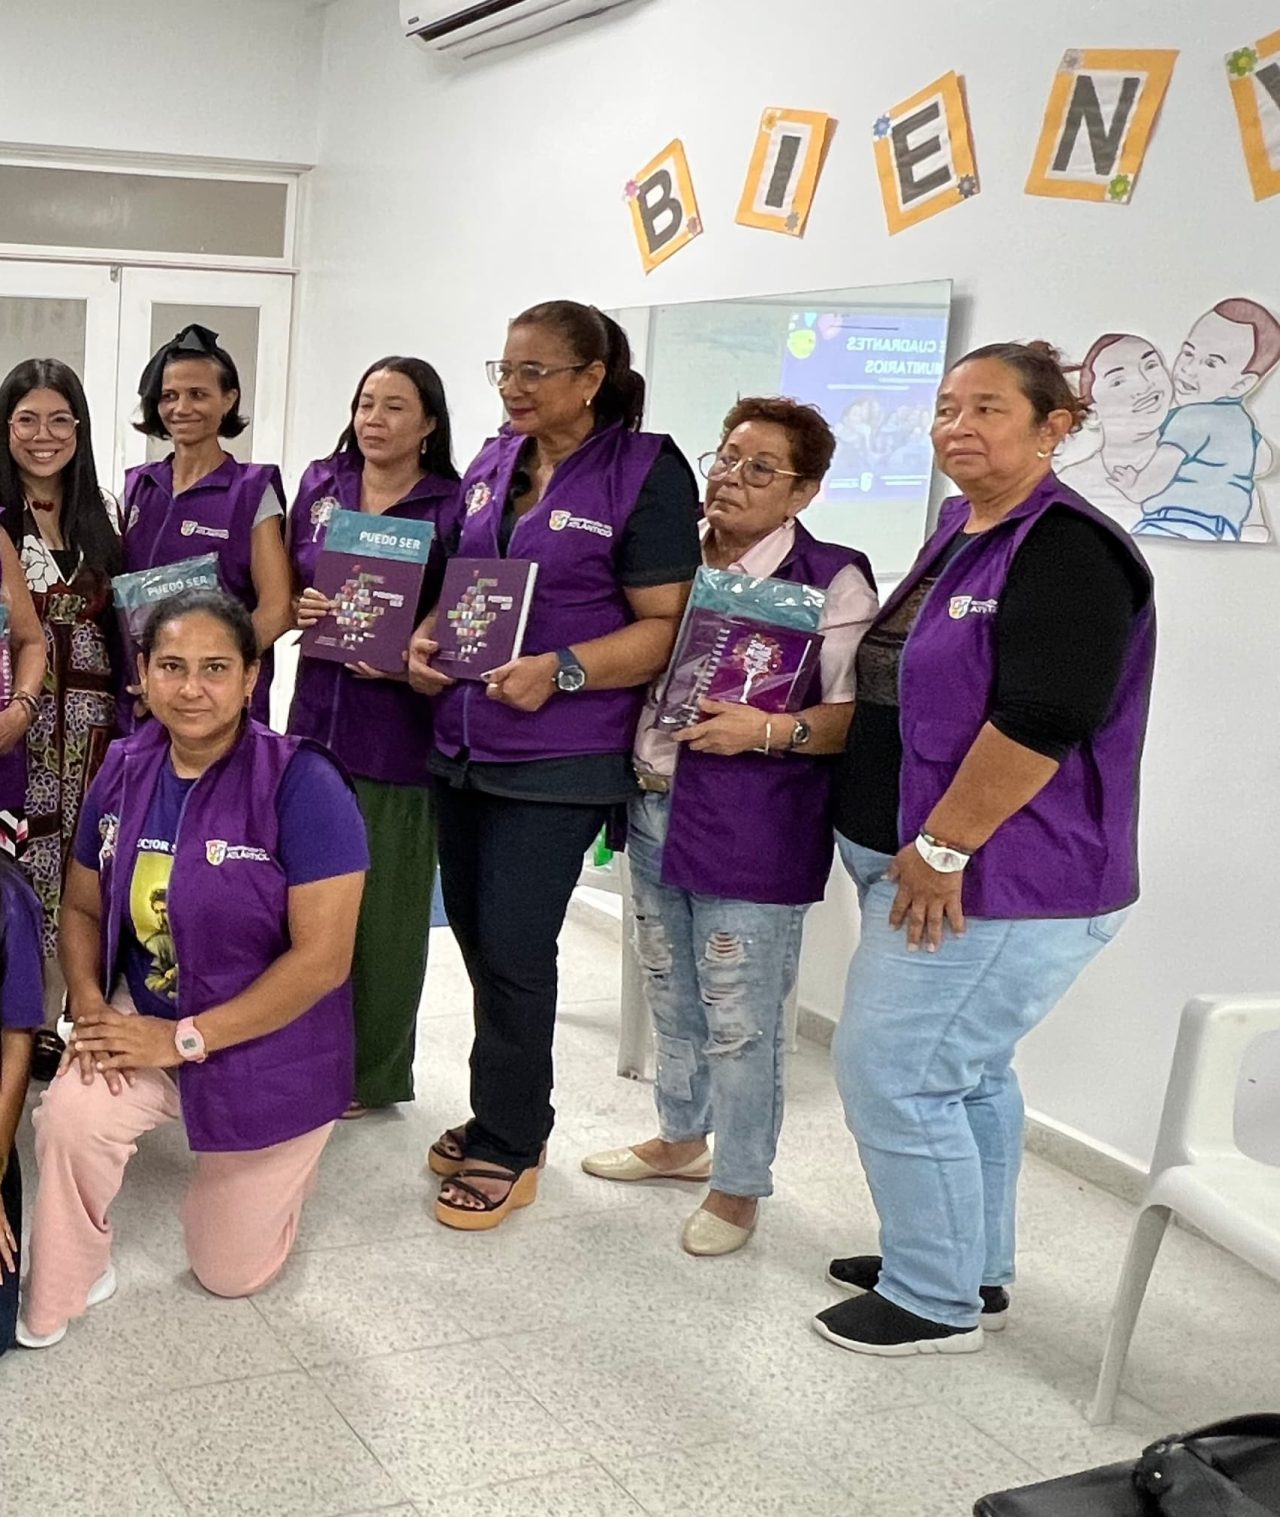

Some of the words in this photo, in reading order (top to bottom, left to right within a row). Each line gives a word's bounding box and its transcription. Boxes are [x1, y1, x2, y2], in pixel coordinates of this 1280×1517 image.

[359, 530, 397, 546] PUEDO
[399, 537, 421, 550] SER
[147, 580, 184, 596] PUEDO
[185, 575, 208, 588] SER
